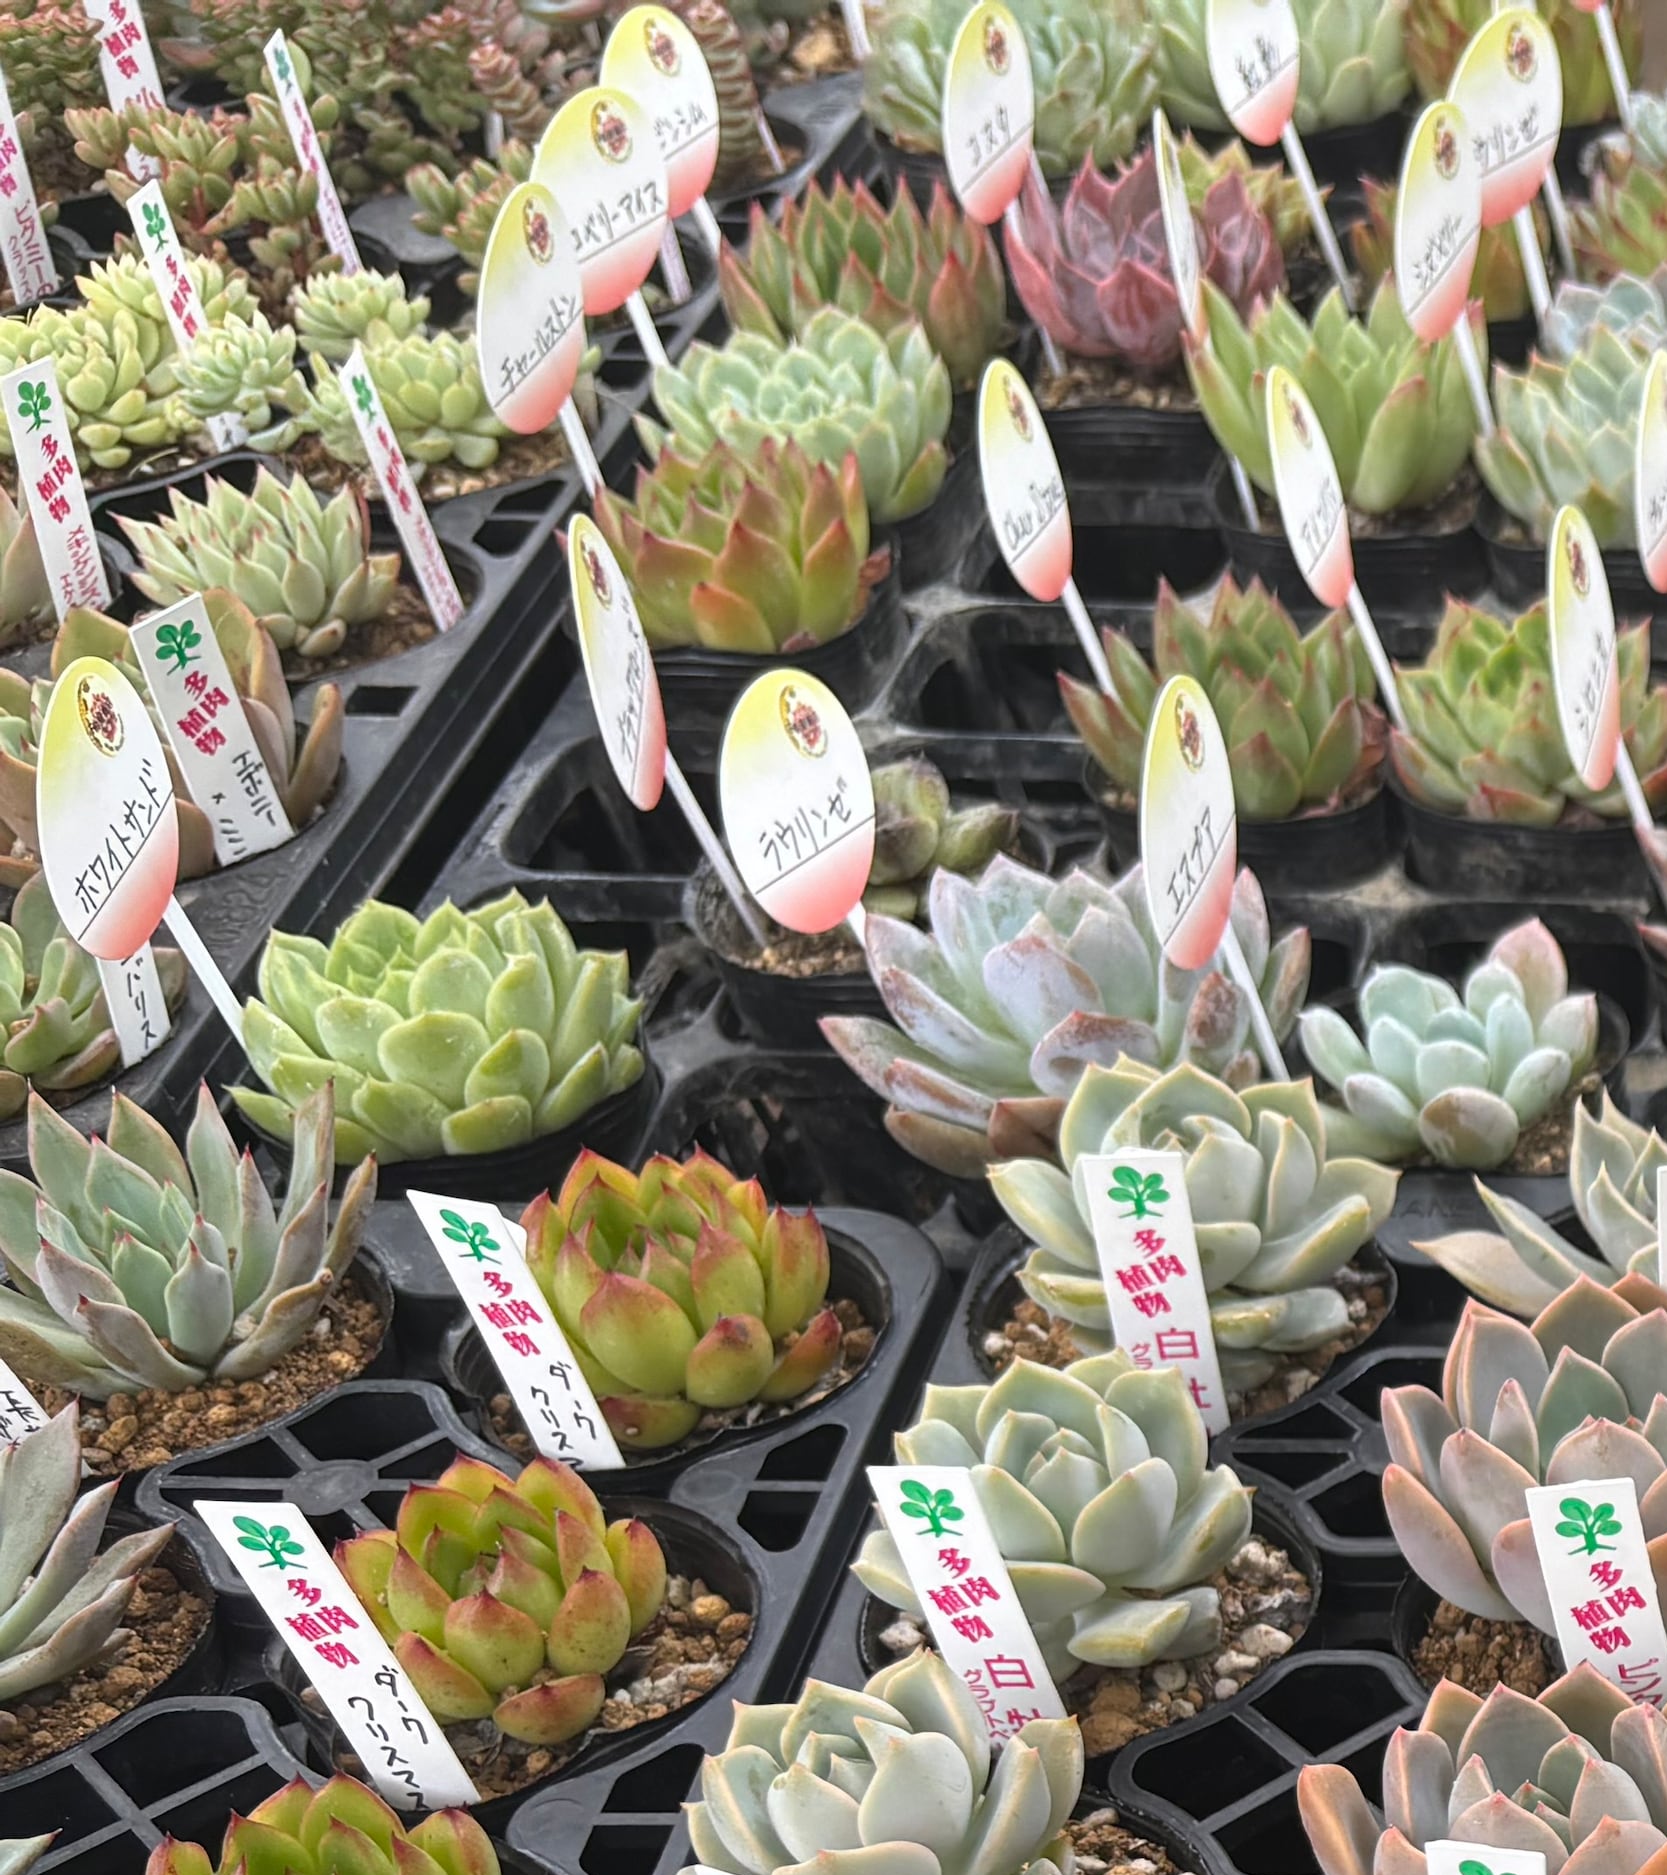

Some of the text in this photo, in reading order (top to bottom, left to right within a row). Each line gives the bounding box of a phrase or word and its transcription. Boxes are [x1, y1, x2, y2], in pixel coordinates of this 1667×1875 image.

[179, 672, 228, 754] 多肉植物
[74, 757, 161, 914] ホワイトサンド
[762, 776, 852, 872] ラウリンゼ
[481, 1272, 542, 1356] 多肉植物
[1116, 1229, 1186, 1318] 多肉植物
[549, 1361, 596, 1440] ダーク
[285, 1578, 360, 1669] 多肉植物
[929, 1548, 1000, 1643] 多肉植物
[1571, 1561, 1646, 1653] 多肉植物
[375, 1664, 429, 1745] ダーク
[348, 1696, 432, 1811] クリスマス
